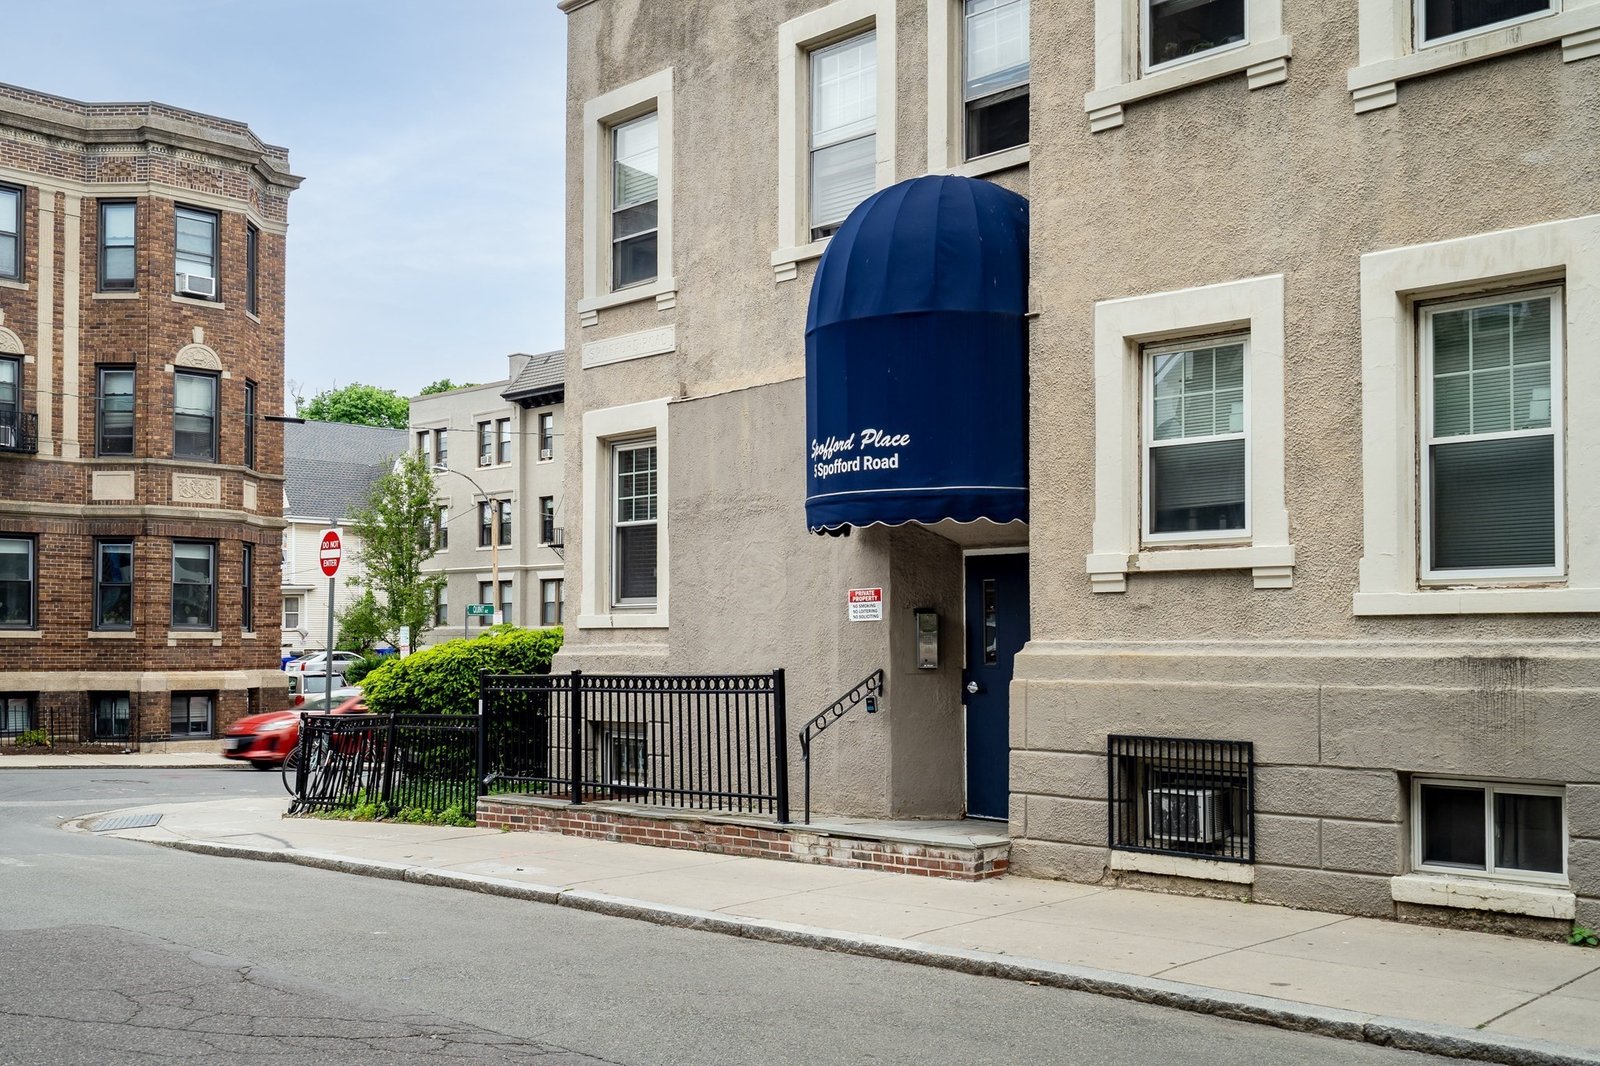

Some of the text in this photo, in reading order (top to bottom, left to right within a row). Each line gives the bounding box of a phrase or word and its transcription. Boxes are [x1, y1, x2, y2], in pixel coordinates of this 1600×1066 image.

[811, 428, 911, 461] Spofford Place
[818, 456, 860, 479] Spofford
[863, 453, 899, 470] Road
